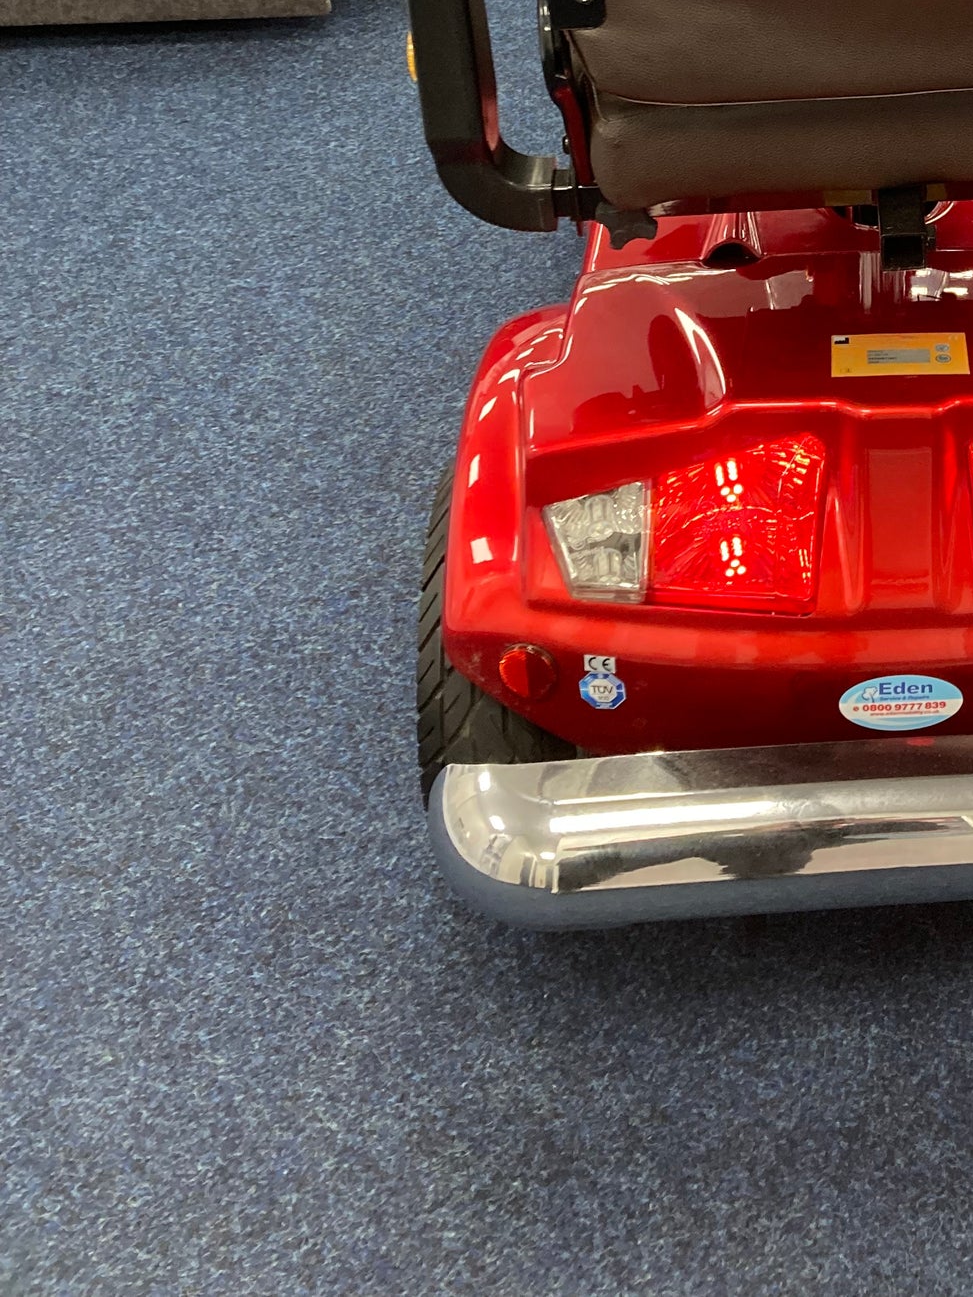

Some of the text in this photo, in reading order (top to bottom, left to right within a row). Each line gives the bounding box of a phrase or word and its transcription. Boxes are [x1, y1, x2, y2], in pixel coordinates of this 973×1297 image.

[878, 682, 934, 695] Eden
[862, 701, 947, 712] 0800 9777 839
